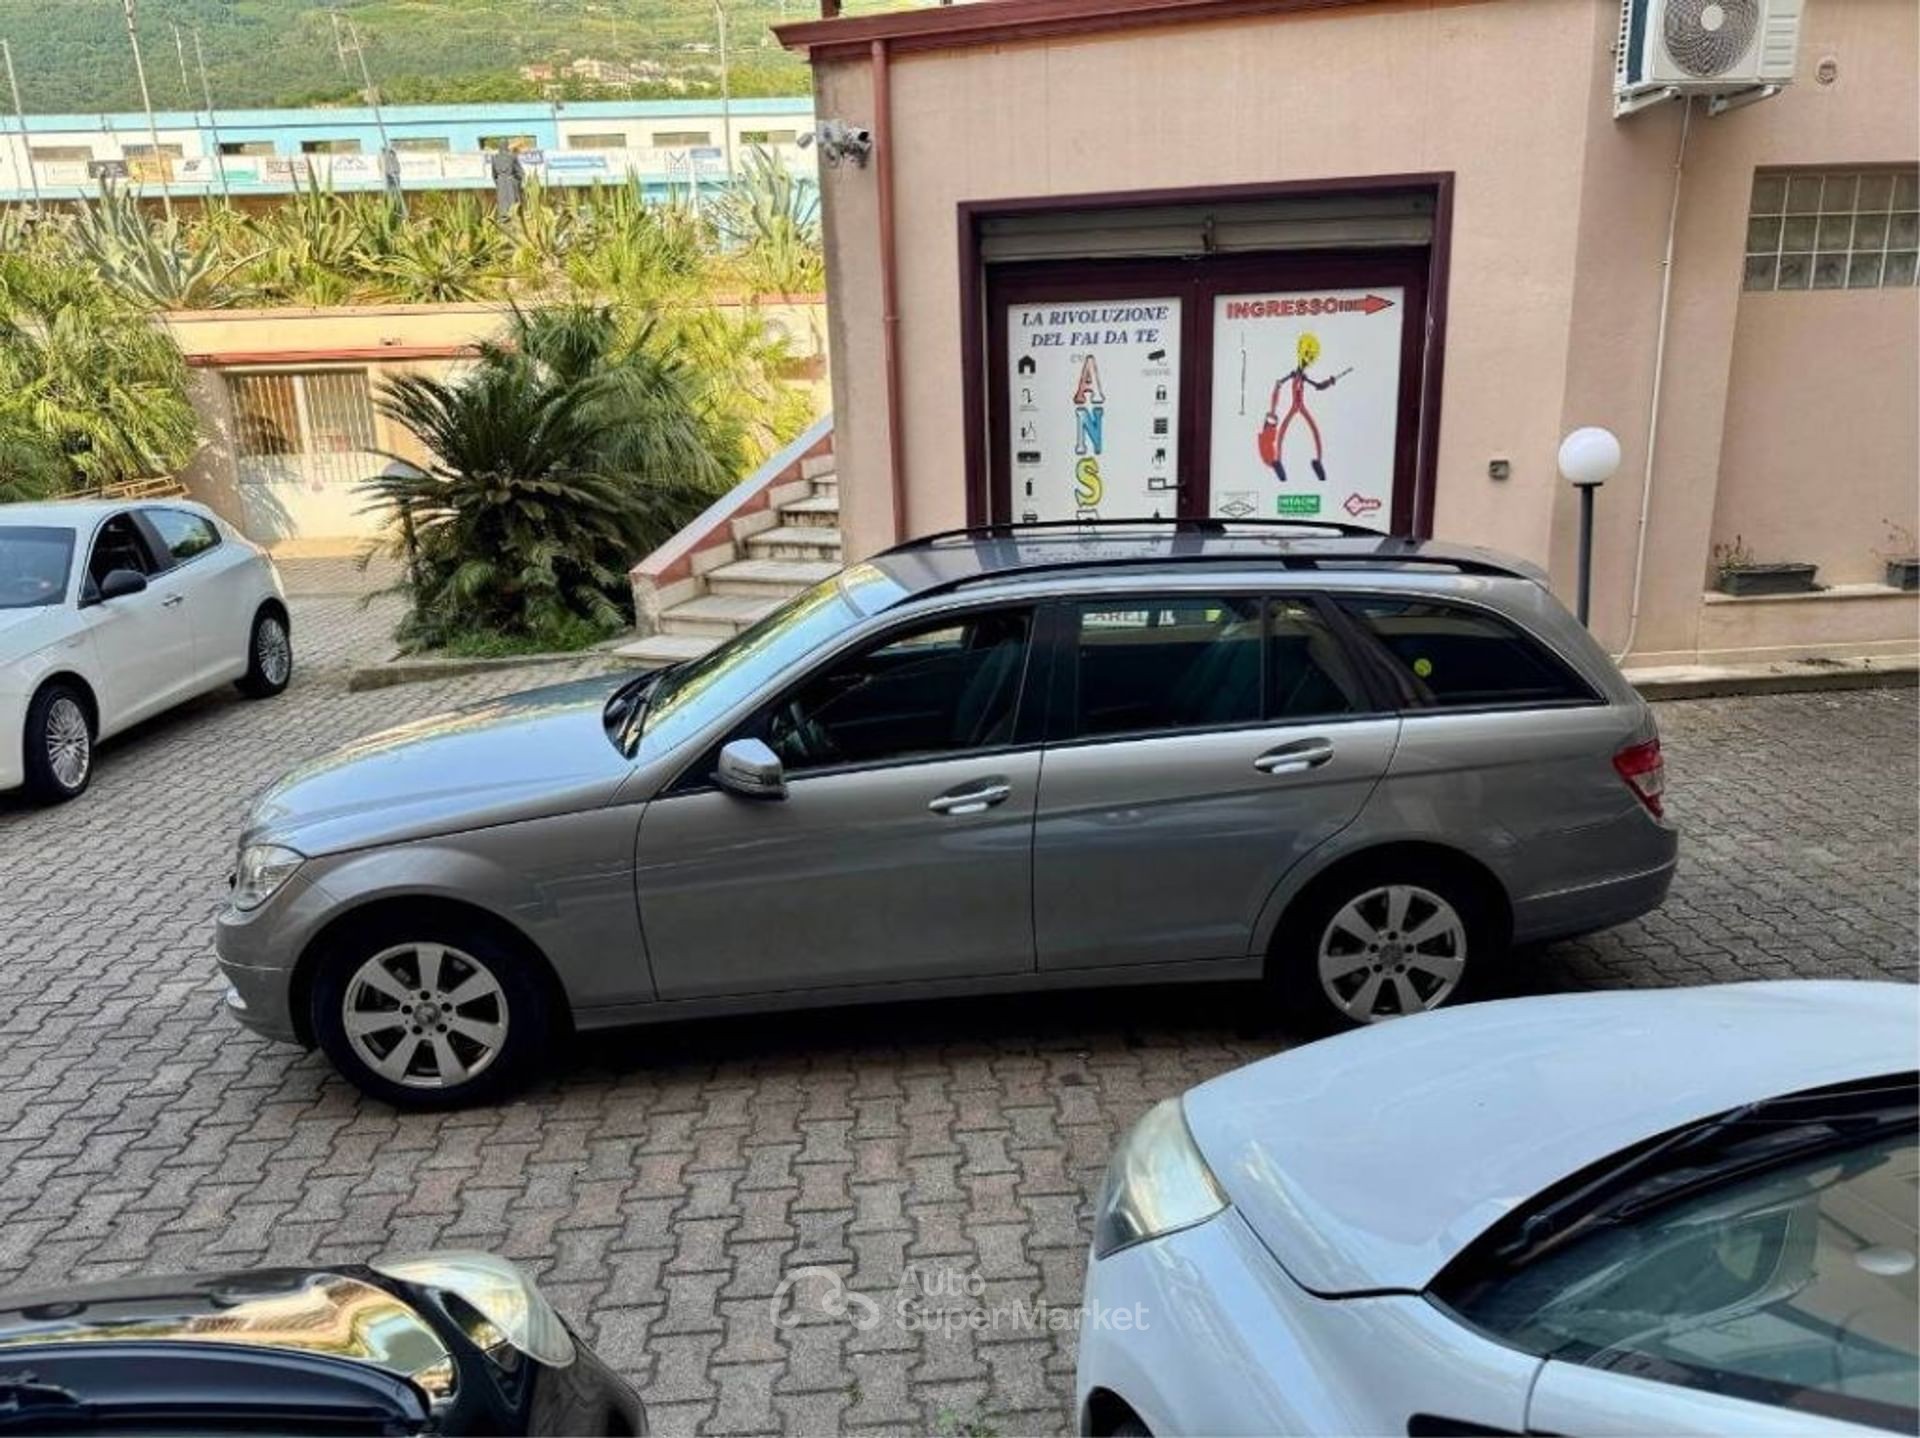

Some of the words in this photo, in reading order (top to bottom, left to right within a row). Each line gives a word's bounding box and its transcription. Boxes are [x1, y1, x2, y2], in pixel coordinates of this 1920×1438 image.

[1022, 312, 1043, 326] LA
[1049, 306, 1169, 325] RIVOLUZIONE
[1227, 298, 1338, 318] INGRESSO
[1031, 333, 1064, 347] DEL
[1070, 331, 1099, 346] FAI
[1105, 330, 1128, 344] DA
[1135, 328, 1159, 343] TE
